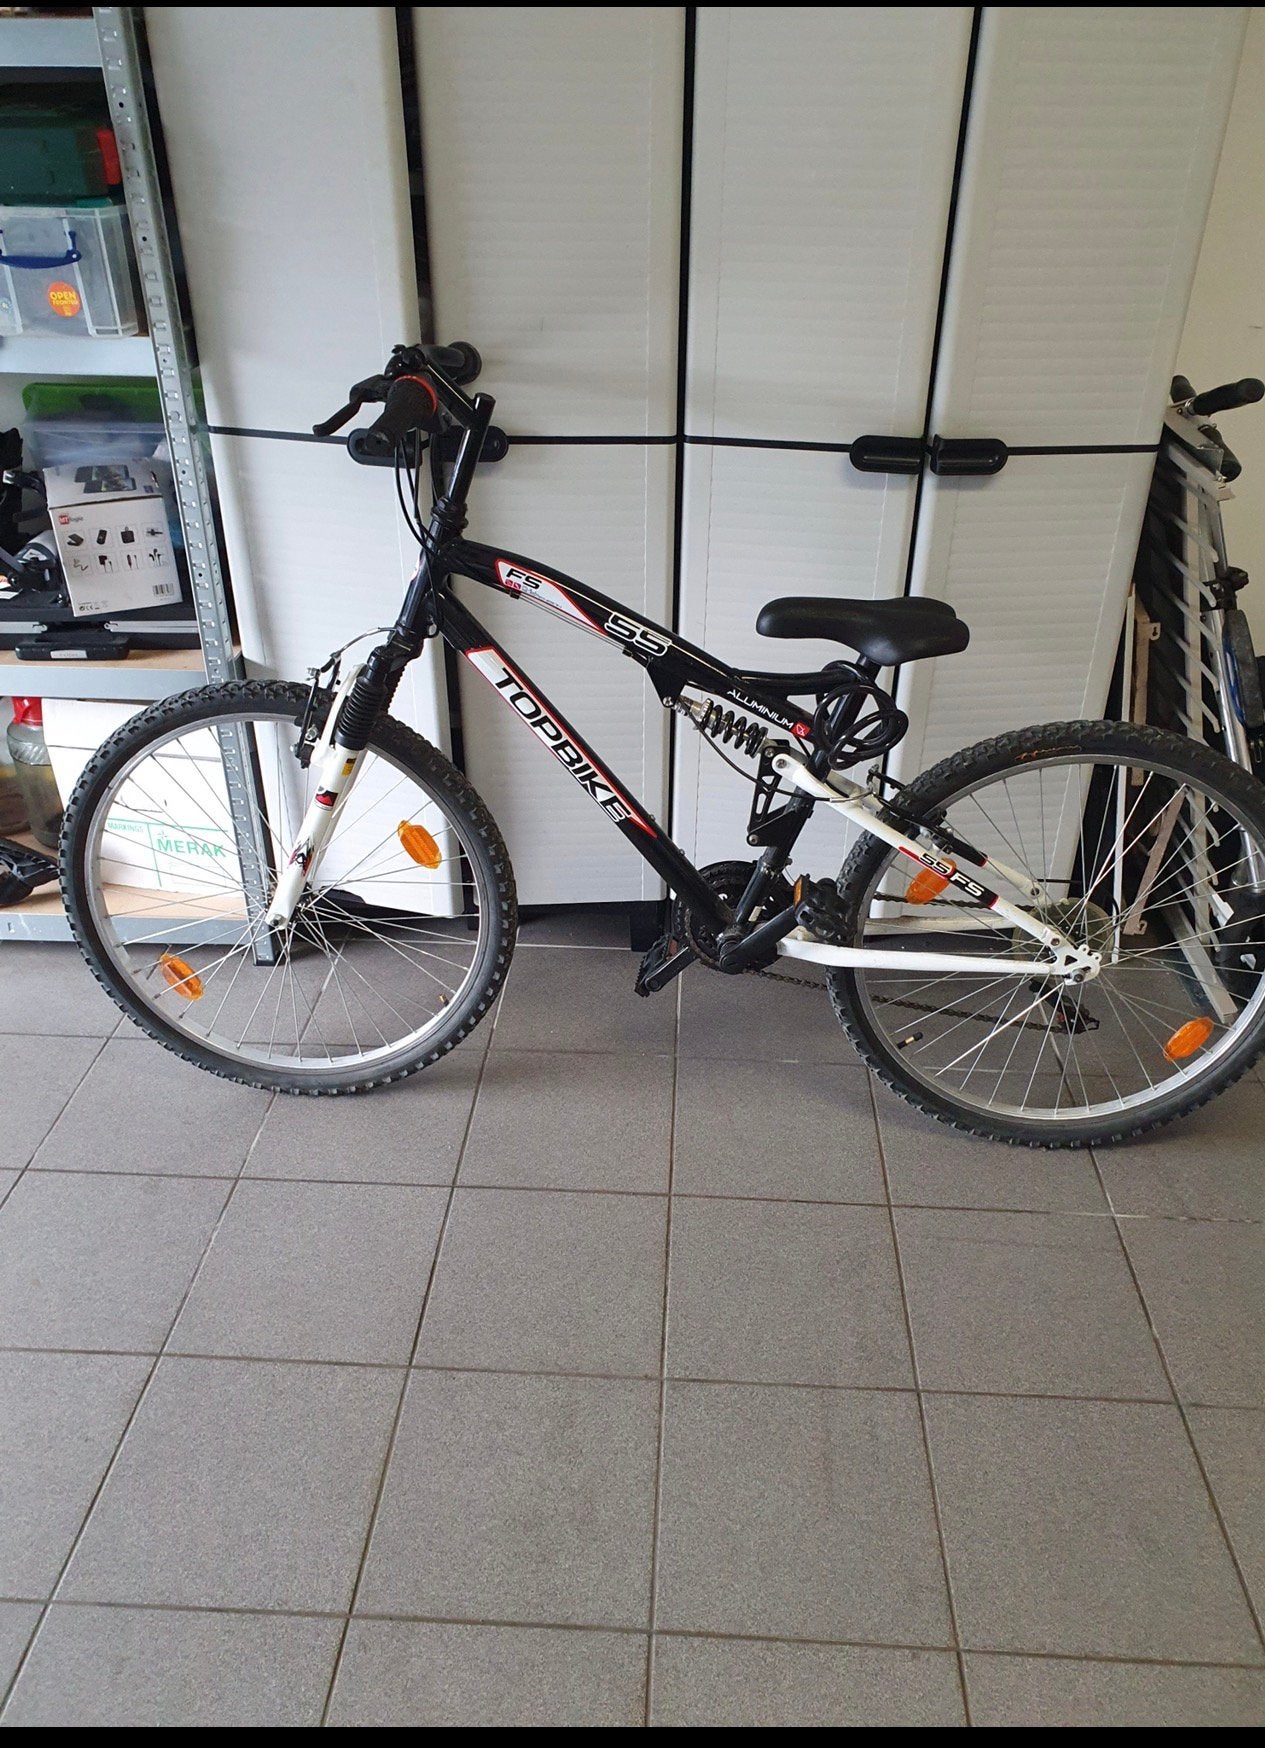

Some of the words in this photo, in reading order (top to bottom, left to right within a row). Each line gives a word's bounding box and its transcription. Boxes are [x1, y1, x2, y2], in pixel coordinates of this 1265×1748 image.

[50, 291, 77, 300] OPEN
[506, 568, 542, 590] FS
[726, 689, 794, 729] ALUMINIUM
[495, 667, 632, 822] TOPBIKE
[157, 838, 226, 858] MERAK
[950, 872, 985, 897] FS
